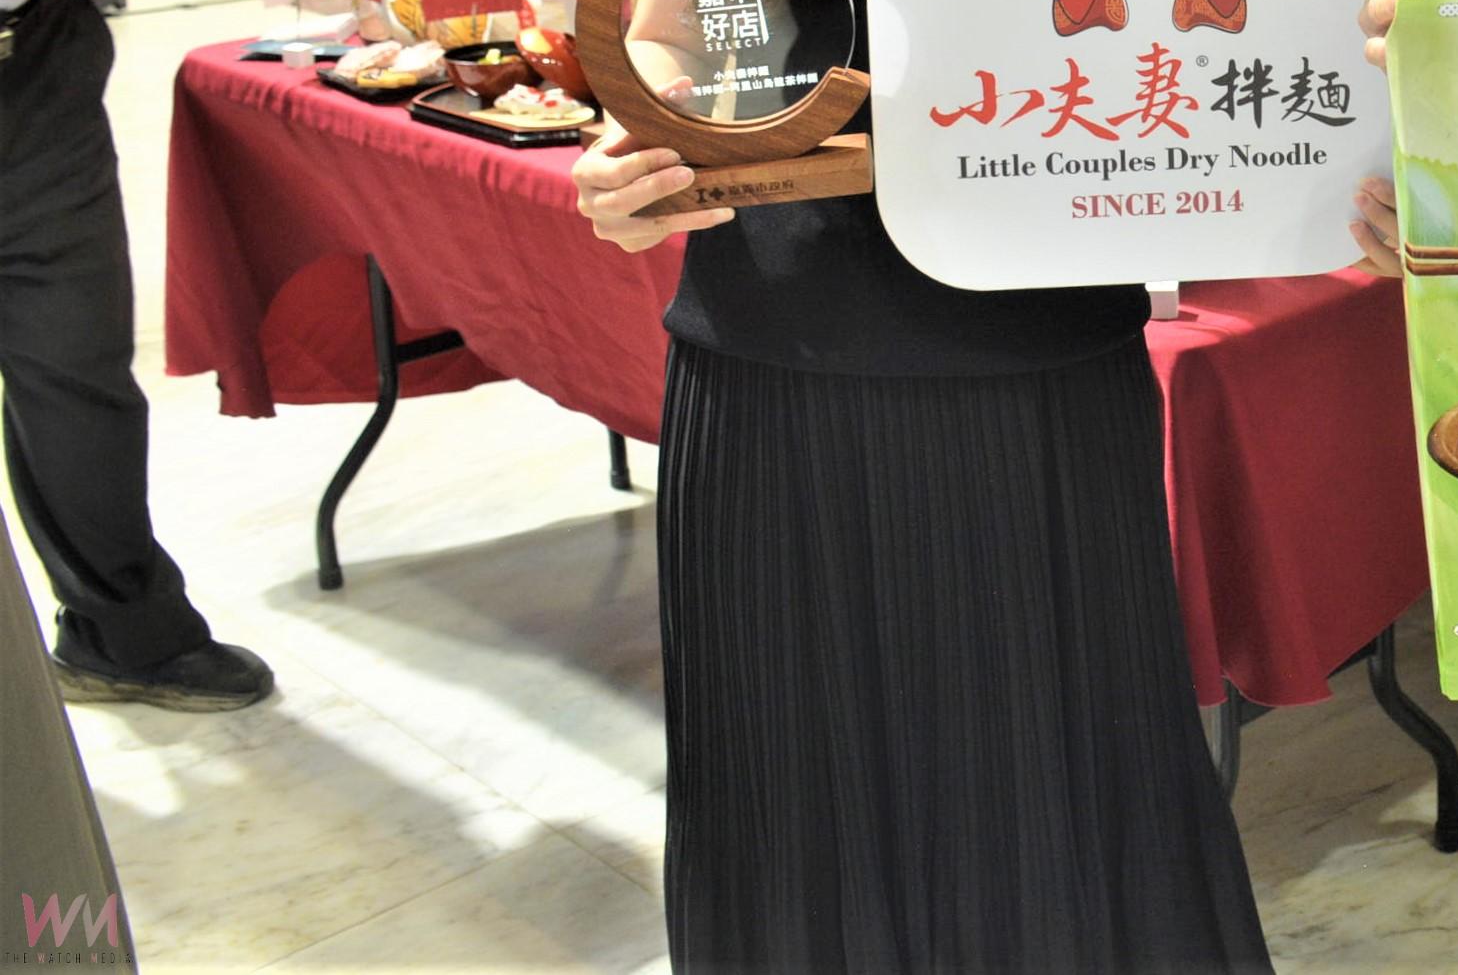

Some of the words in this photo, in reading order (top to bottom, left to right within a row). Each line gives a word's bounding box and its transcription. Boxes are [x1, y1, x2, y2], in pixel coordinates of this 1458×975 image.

[701, 9, 760, 42] 好店
[706, 37, 762, 53] SELECT
[956, 155, 1037, 180] Little
[1045, 151, 1157, 181] Couples
[1165, 147, 1220, 176] Dry
[1228, 143, 1328, 168] Noodle
[1070, 193, 1167, 219] SINCE
[1175, 189, 1244, 215] 2014
